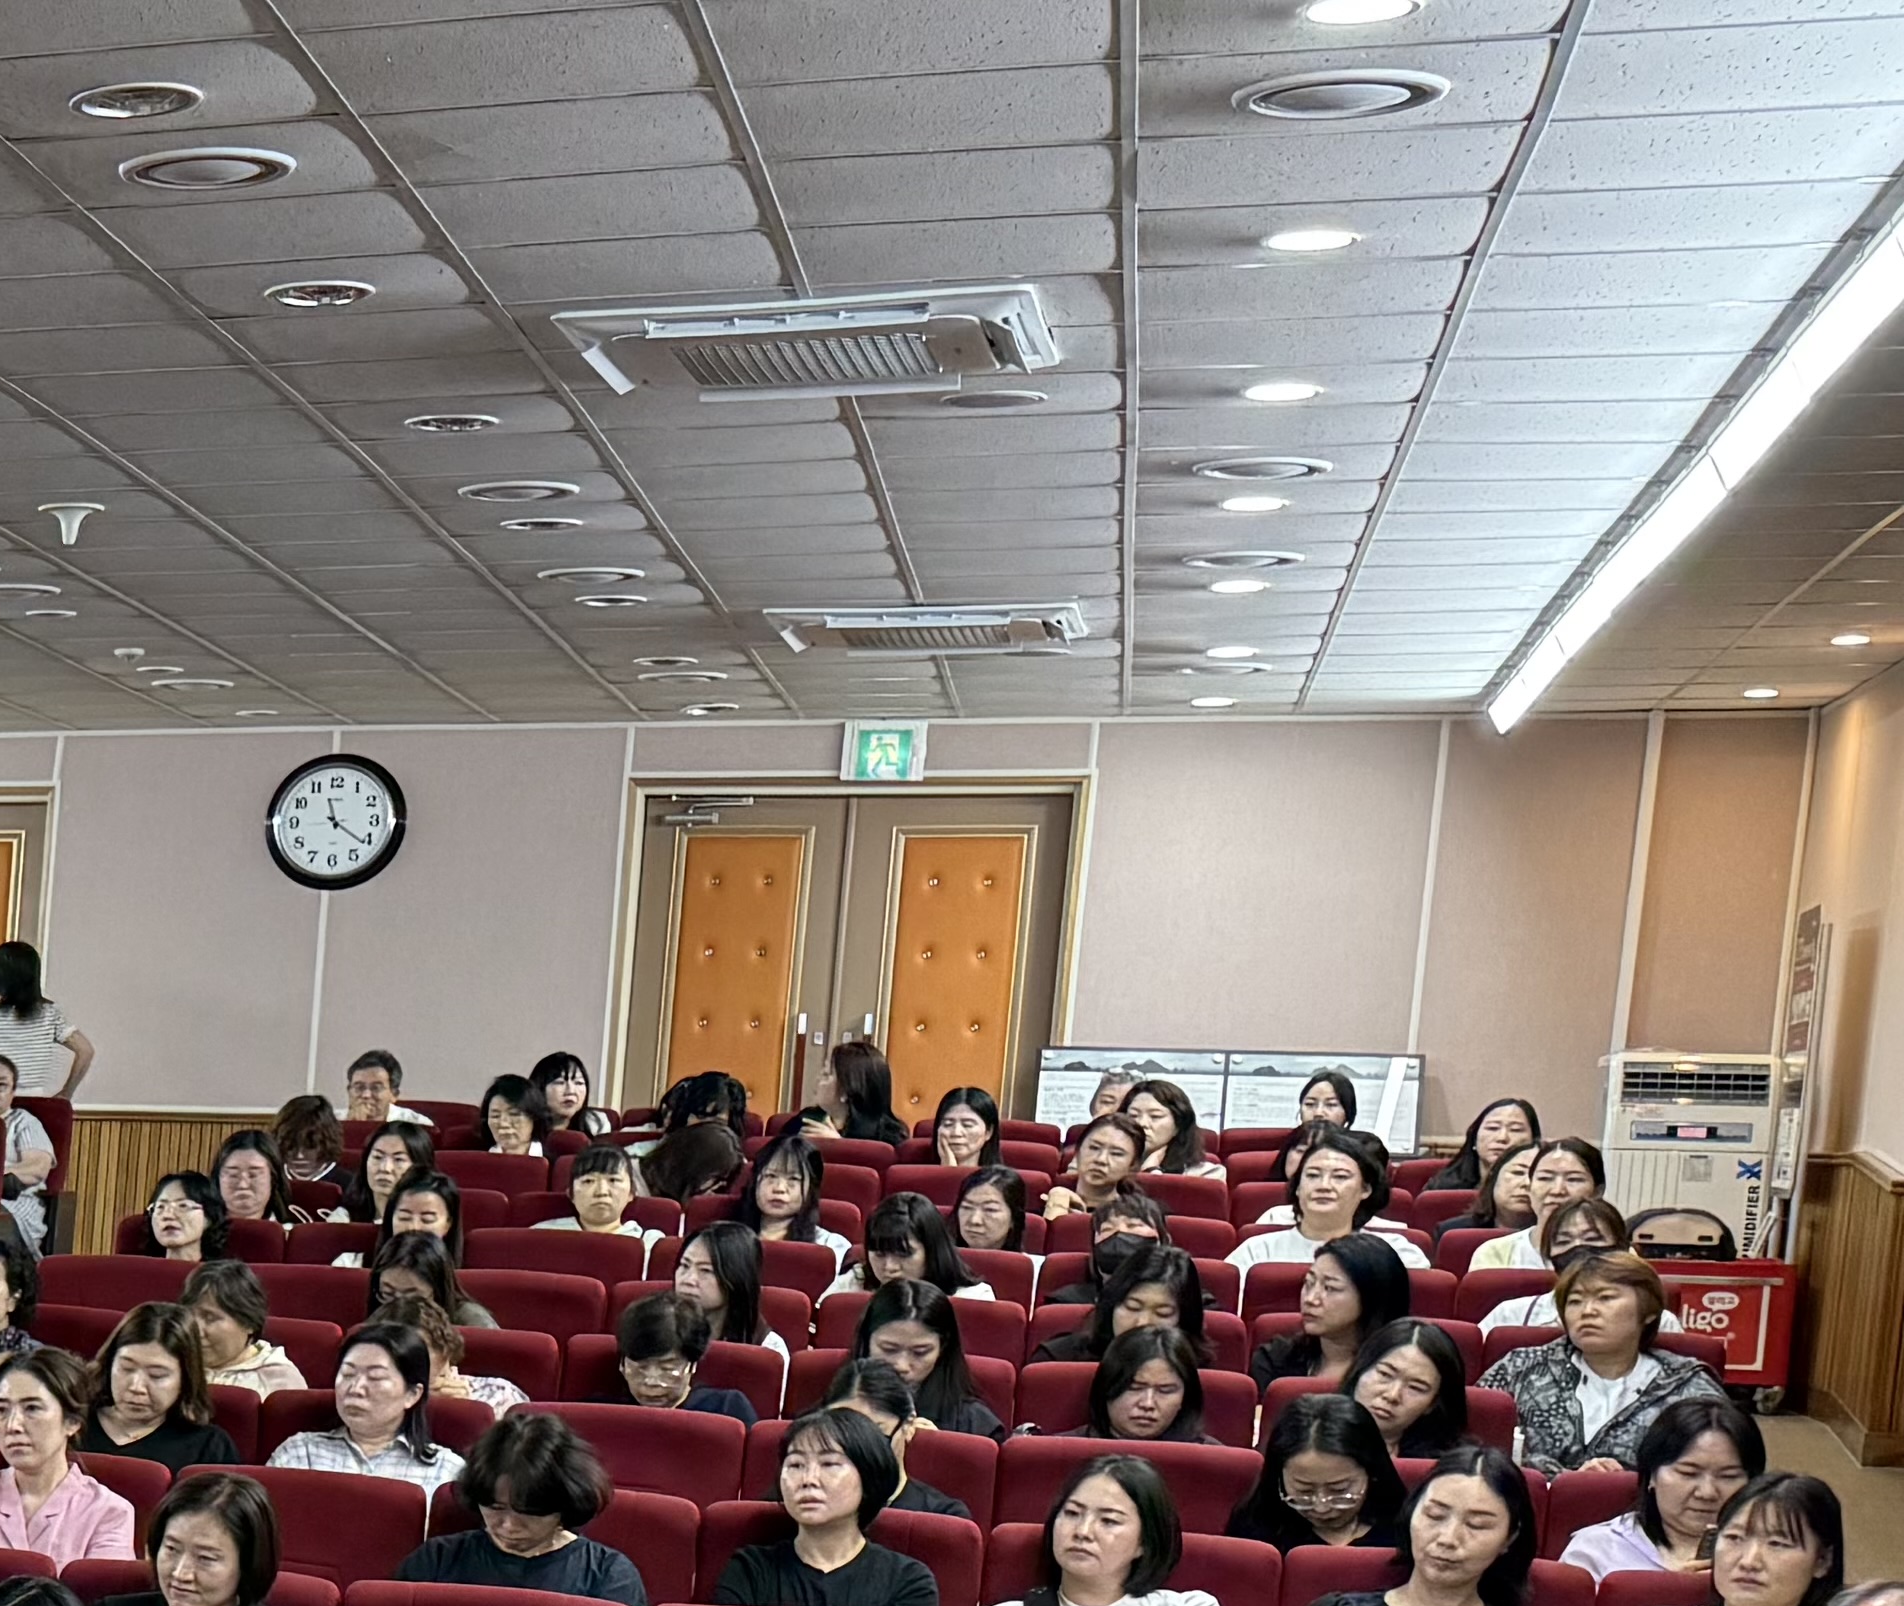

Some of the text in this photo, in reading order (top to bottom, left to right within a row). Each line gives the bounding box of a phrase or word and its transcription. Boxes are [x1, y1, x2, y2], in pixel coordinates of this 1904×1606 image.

[311, 781, 322, 794] 11
[330, 776, 345, 789] 12
[355, 781, 360, 794] 1
[295, 797, 308, 810] 10
[365, 795, 377, 808] 2
[289, 816, 300, 829] 9
[369, 814, 380, 827] 3
[293, 836, 305, 850] 8
[361, 832, 372, 846] 4
[307, 850, 319, 864] 7
[327, 853, 338, 868] 6
[348, 848, 359, 862] 5
